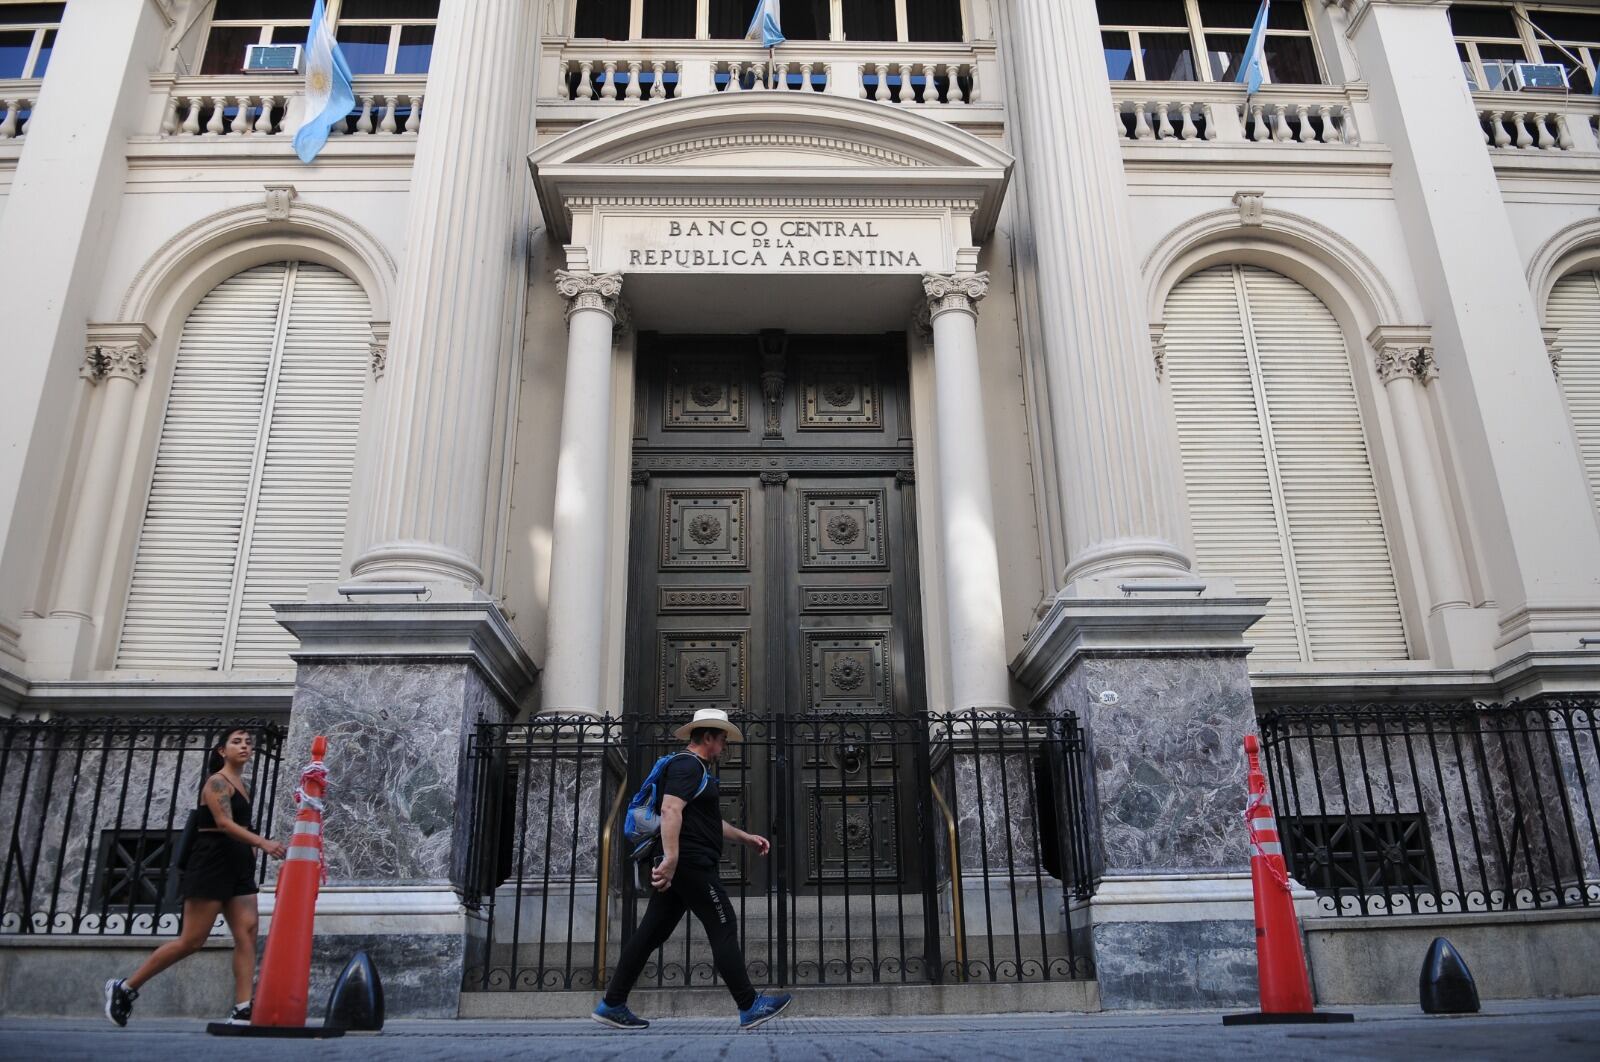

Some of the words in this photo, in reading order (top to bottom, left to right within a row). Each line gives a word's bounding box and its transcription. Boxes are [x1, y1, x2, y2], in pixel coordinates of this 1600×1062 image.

[668, 220, 768, 237] BANCO
[780, 221, 879, 238] CENTRAL
[752, 238, 771, 249] DE
[776, 238, 795, 249] LA
[629, 249, 768, 266] REPUBLICA
[779, 250, 922, 267] ARGENTINA
